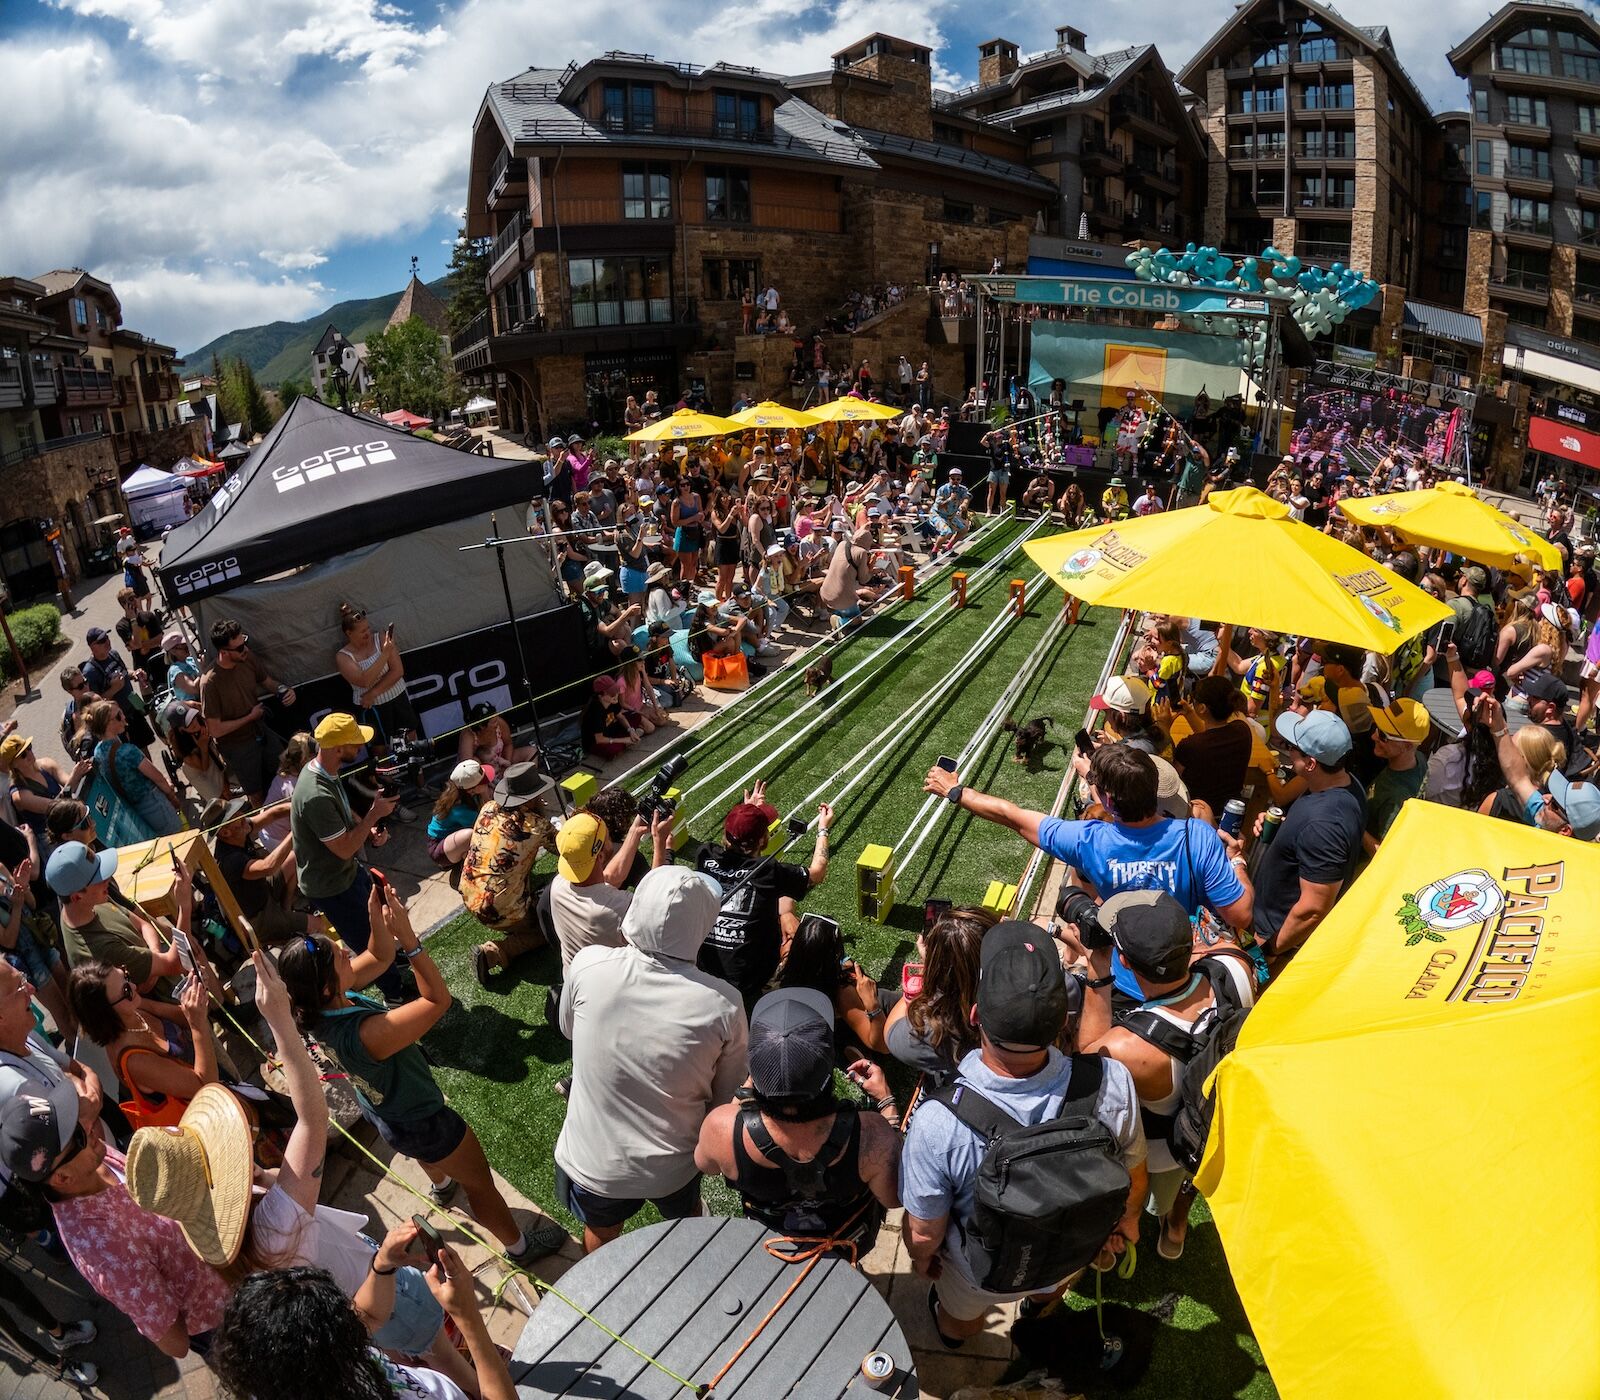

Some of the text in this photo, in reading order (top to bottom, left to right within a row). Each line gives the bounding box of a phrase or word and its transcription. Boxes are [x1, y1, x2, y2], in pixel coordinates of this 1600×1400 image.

[1067, 246, 1096, 257] CHASE
[1060, 283, 1180, 309] The CoLab
[271, 440, 390, 482] GoPro
[173, 556, 239, 587] GoPro
[1462, 860, 1564, 1004] PACIFICO
[1404, 949, 1458, 1000] CLARA
